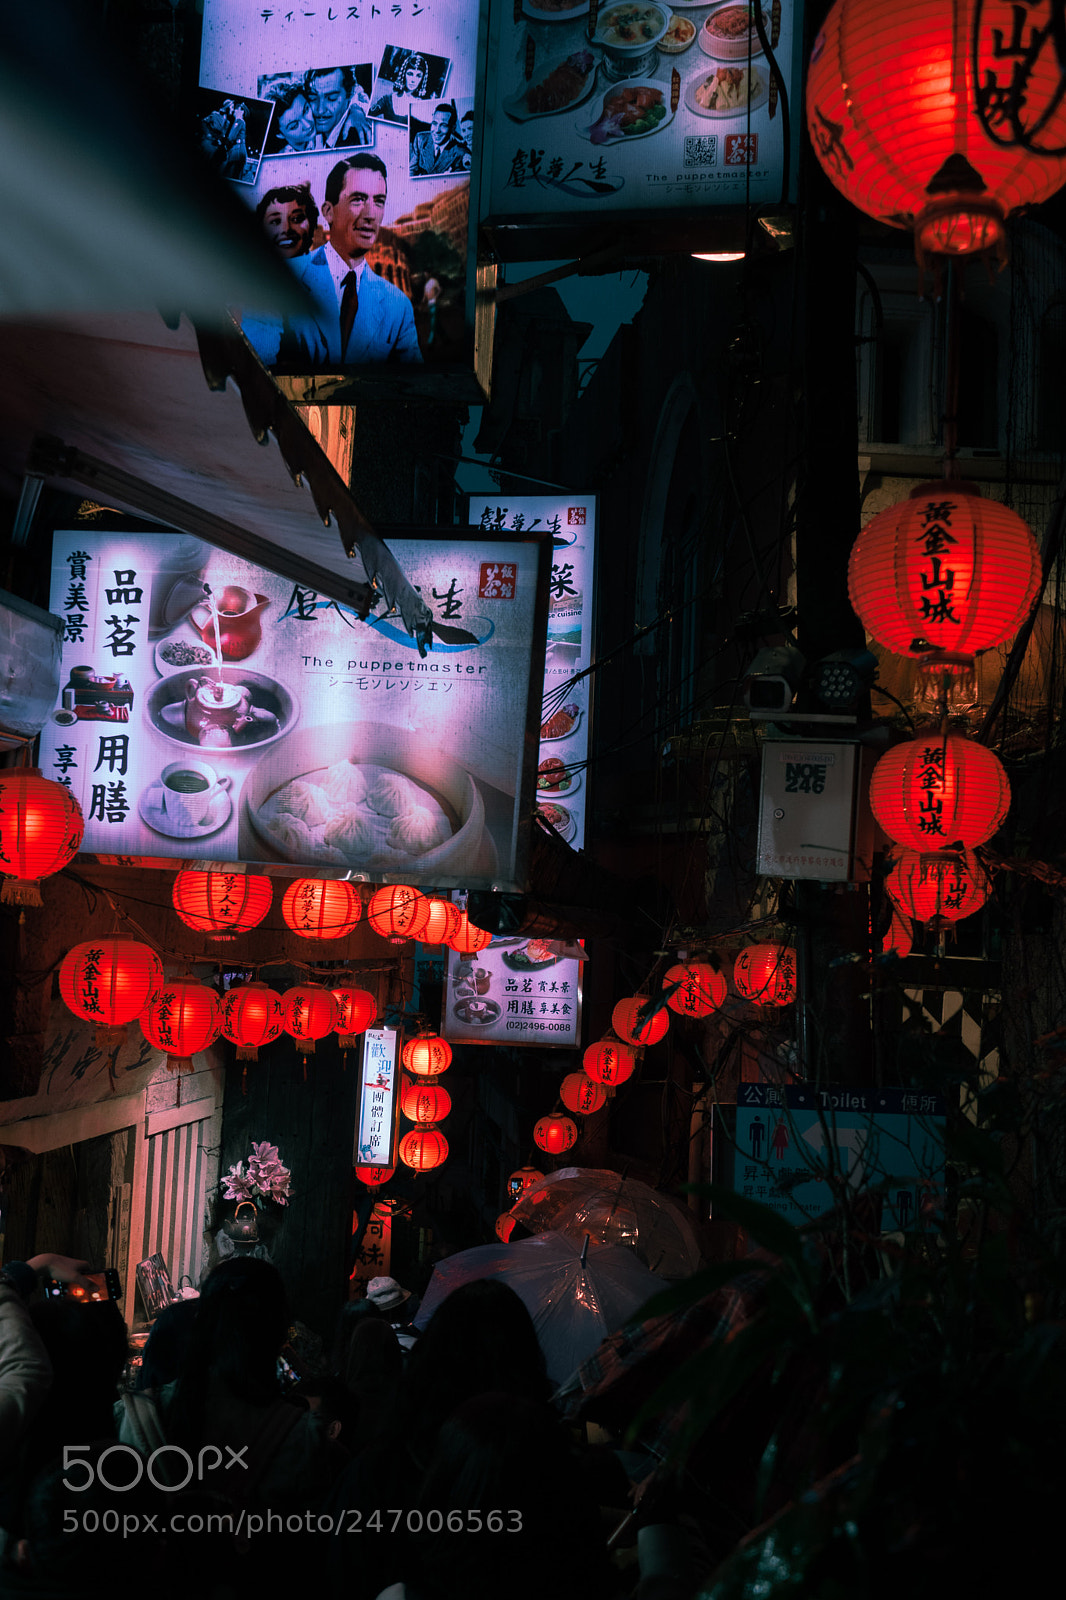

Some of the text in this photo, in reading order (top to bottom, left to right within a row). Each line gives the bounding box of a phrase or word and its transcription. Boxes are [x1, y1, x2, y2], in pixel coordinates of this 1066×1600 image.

[646, 170, 770, 182] The puppetmaster
[63, 550, 93, 643] 賞美景
[103, 569, 144, 657] 品茗
[557, 609, 583, 618] cuisine
[301, 655, 488, 674] The puppetmaster
[88, 734, 131, 824] 用膳
[785, 777, 825, 794] 246
[219, 873, 238, 918] 夢人生
[505, 978, 534, 993] 品茗
[507, 1000, 536, 1015] 用膳
[506, 1022, 571, 1032] (02)2496-0088
[819, 1091, 867, 1109] Toilet
[790, 1202, 821, 1212] Tater
